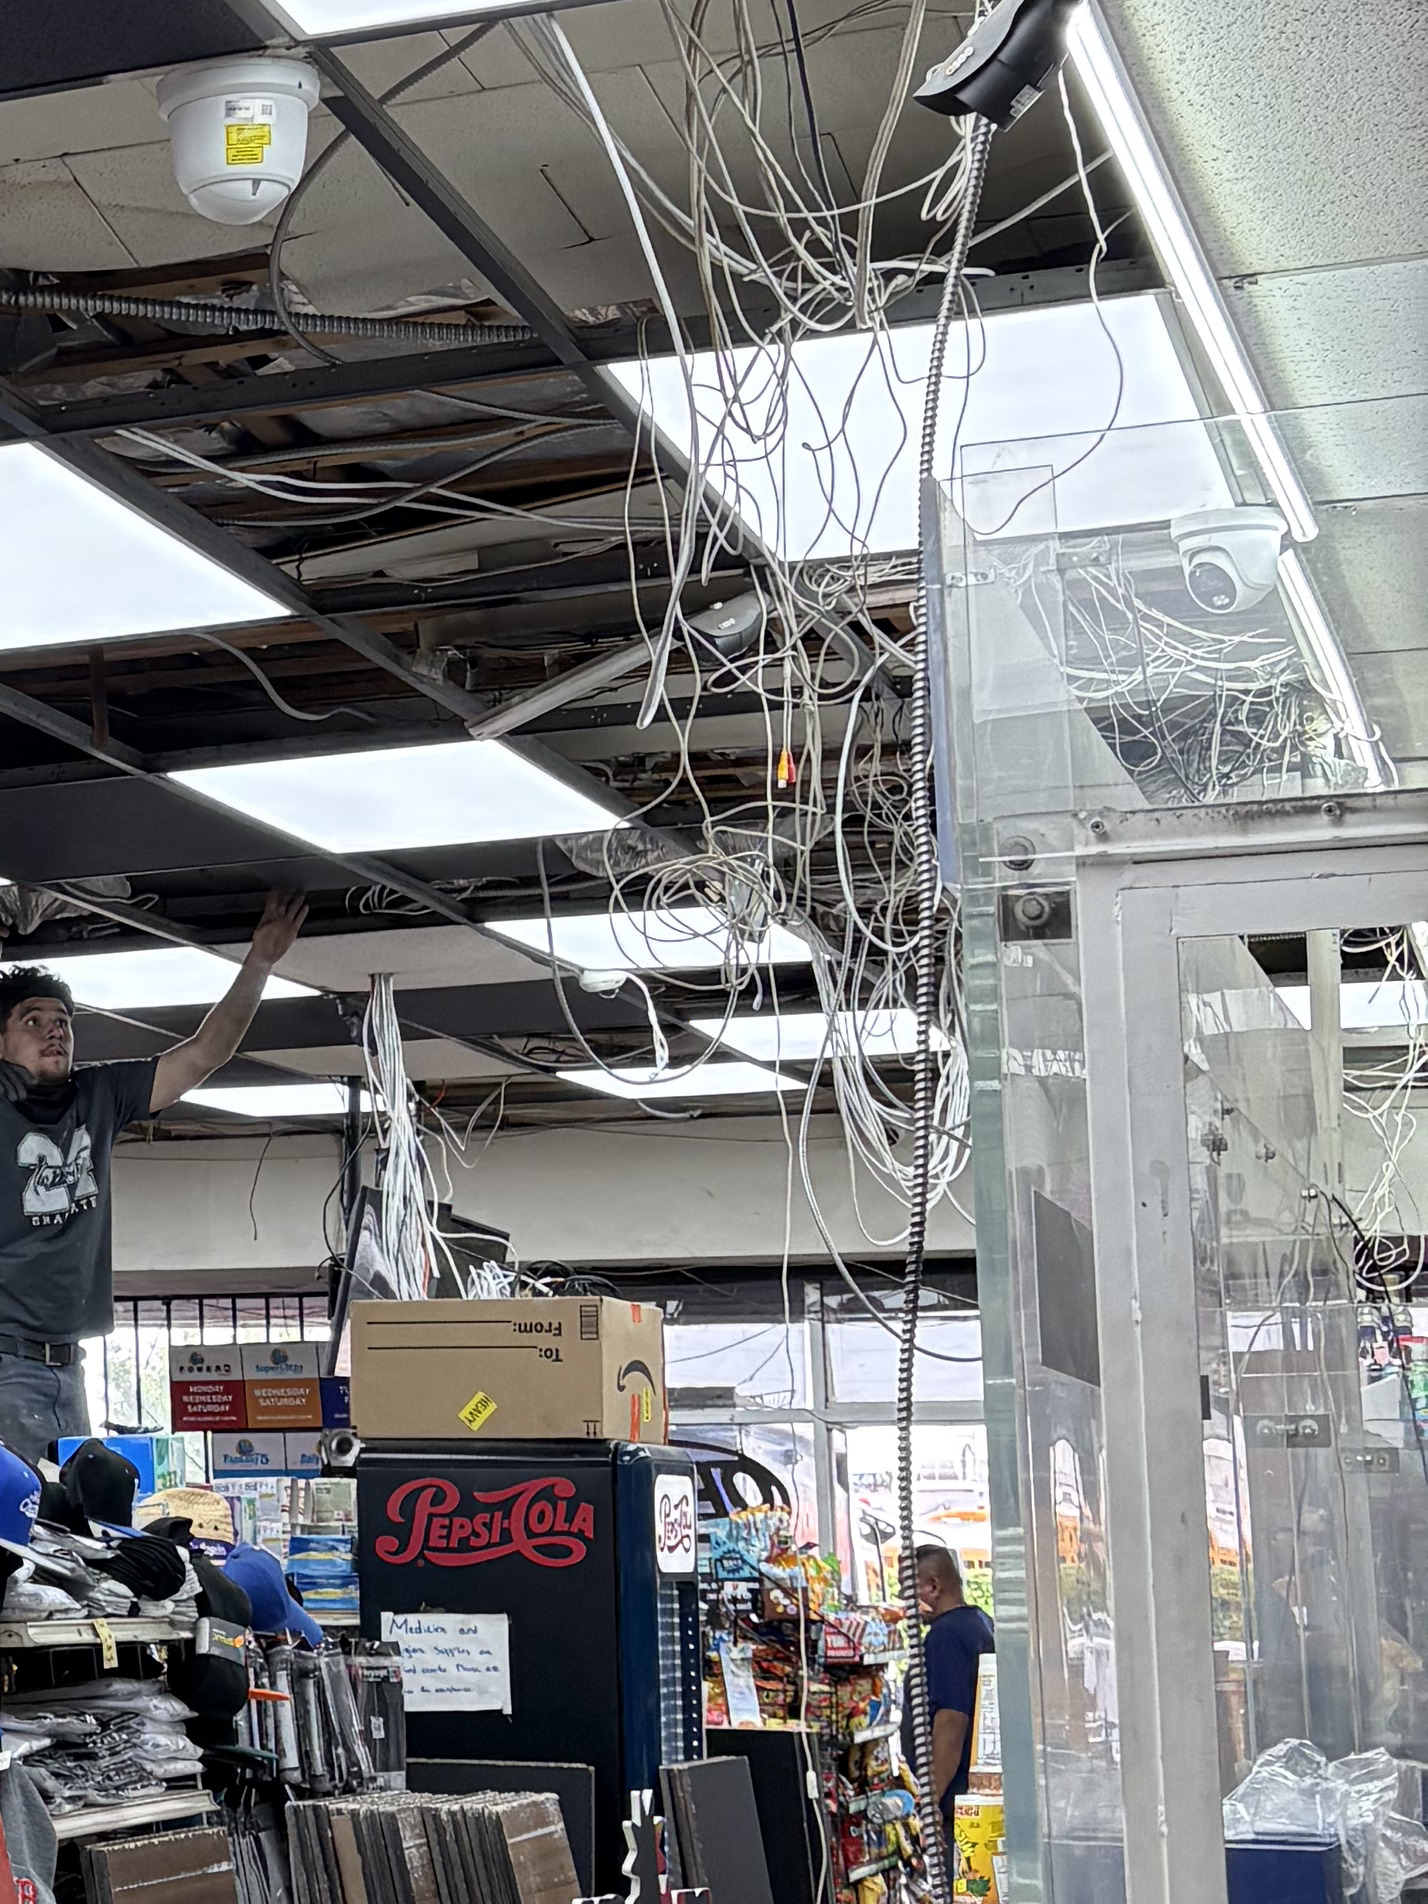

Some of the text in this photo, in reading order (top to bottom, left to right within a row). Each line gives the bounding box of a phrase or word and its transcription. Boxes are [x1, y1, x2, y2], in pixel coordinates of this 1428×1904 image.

[513, 1321, 562, 1336] From:
[538, 1347, 563, 1362] To:
[190, 1385, 223, 1393] MONDAY
[255, 1387, 310, 1397] WEDNESDAY
[182, 1394, 232, 1403] WEDNESDAY
[260, 1398, 306, 1407] SATURDAY
[187, 1404, 230, 1413] SATURDAY
